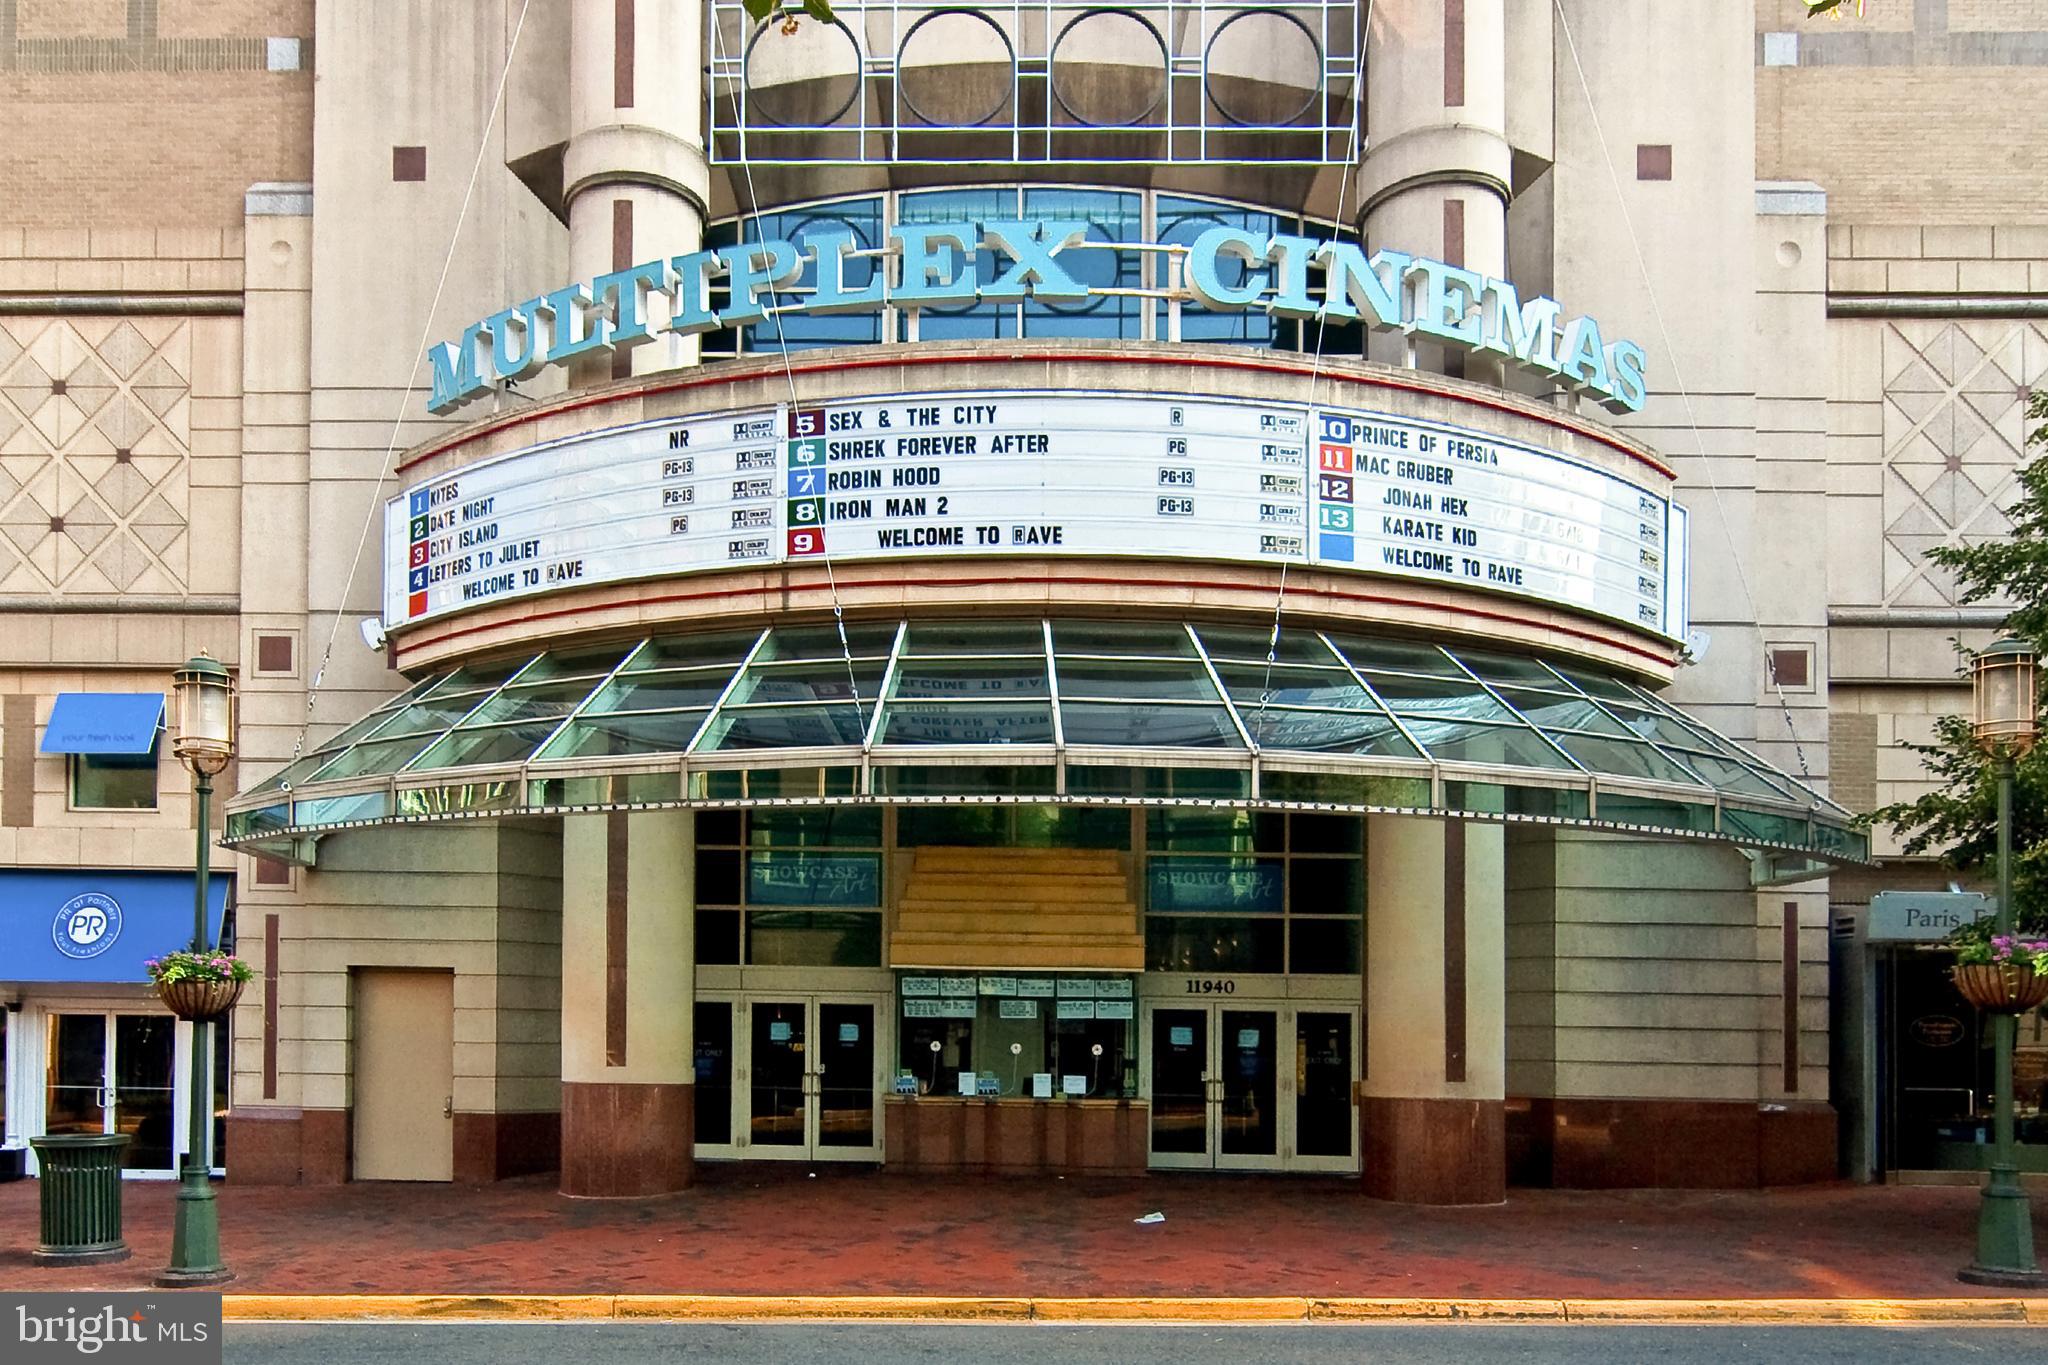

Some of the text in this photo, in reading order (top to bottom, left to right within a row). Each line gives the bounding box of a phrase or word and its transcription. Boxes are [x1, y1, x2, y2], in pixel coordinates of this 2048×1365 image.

[427, 221, 1647, 415] MULTIPLEX CINEMAS
[796, 405, 997, 433] 5 SEX & THE CITY
[1172, 410, 1181, 424] R
[669, 430, 689, 449] NR
[797, 435, 1049, 462] 6 SHREK FOREVER AFTER
[1168, 440, 1185, 454] PG
[1319, 419, 1499, 467] 10 PRINCE OF PERSIA
[664, 460, 692, 477] PG-13
[796, 467, 940, 492] 7 ROBIN HOOD
[1160, 469, 1192, 485] PG-13
[1323, 450, 1453, 486] 11 MAC GRUBER
[416, 482, 458, 512] 1 KITES
[664, 488, 692, 505] PG-13
[796, 496, 948, 521] 8 IRON MAN 2
[1159, 499, 1192, 514] PG-13
[1321, 479, 1468, 517] 12 JONAH HEX
[414, 497, 494, 538] 2 DATE NIGHT
[673, 518, 687, 532] PG
[1321, 507, 1477, 547] 13 KARATE KID
[414, 523, 498, 564] 3 CITY ISLAND
[794, 525, 1062, 552] 9 WELCOME TO RAVE
[413, 540, 540, 587] 4 LETTERS TO JULIET
[1383, 546, 1523, 586] WELCOME TO RAVE
[463, 560, 583, 600] WELCOME TO RAVE
[752, 865, 858, 879] SHOWCASE
[1158, 871, 1263, 885] SHOWCASE
[71, 915, 104, 935] PR
[1905, 909, 1960, 927] Paris
[1186, 980, 1235, 994] 11940
